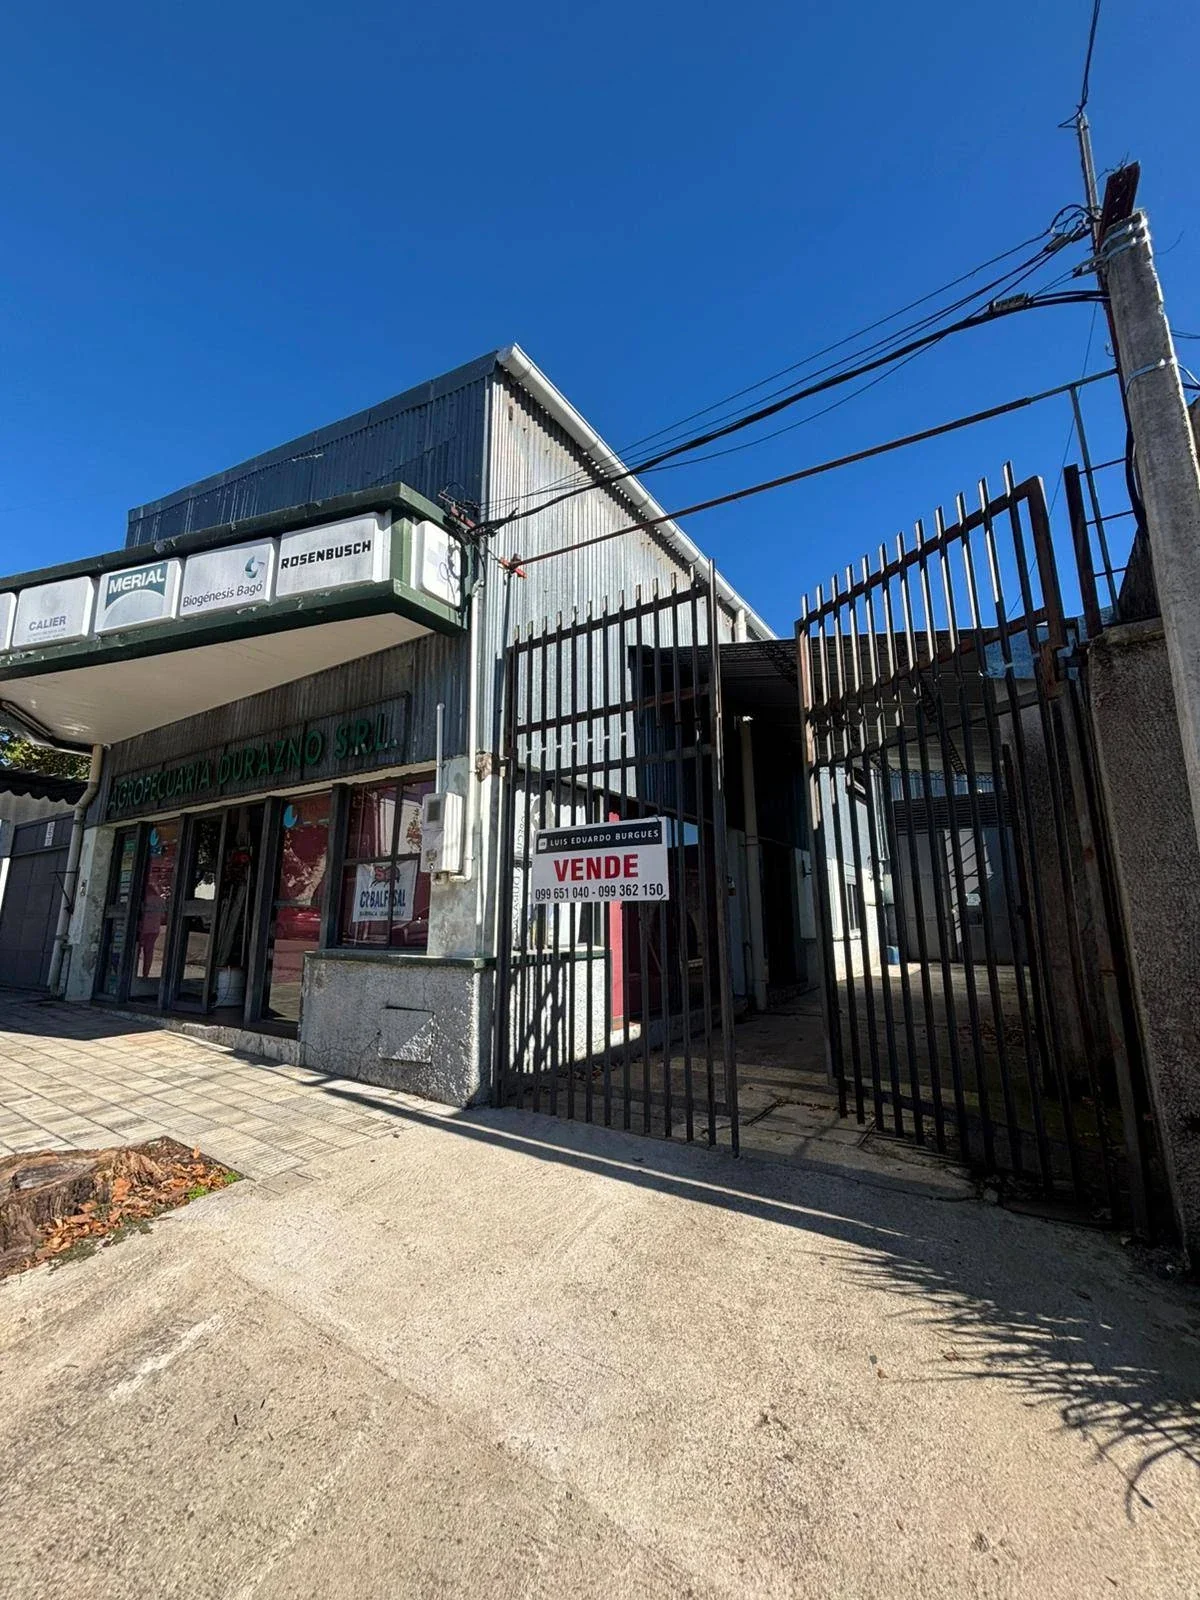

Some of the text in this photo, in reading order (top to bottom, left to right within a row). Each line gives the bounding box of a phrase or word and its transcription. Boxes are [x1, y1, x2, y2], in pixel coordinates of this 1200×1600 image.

[280, 539, 372, 570] ROSENBUSCH
[108, 567, 166, 595] MERIAL
[182, 580, 263, 608] Biogénesis Bagó
[28, 615, 66, 632] CALIER
[107, 759, 213, 812] AGROPECUARIA
[217, 729, 325, 786] DURAZNO
[550, 829, 659, 847] LUIS EDUARDO BURGUES
[554, 853, 639, 882] VENDE
[535, 888, 551, 900] 099
[553, 887, 569, 899] 651
[572, 886, 589, 899] 040
[598, 884, 616, 898] 099
[619, 883, 639, 897] 362
[643, 883, 663, 896] 150
